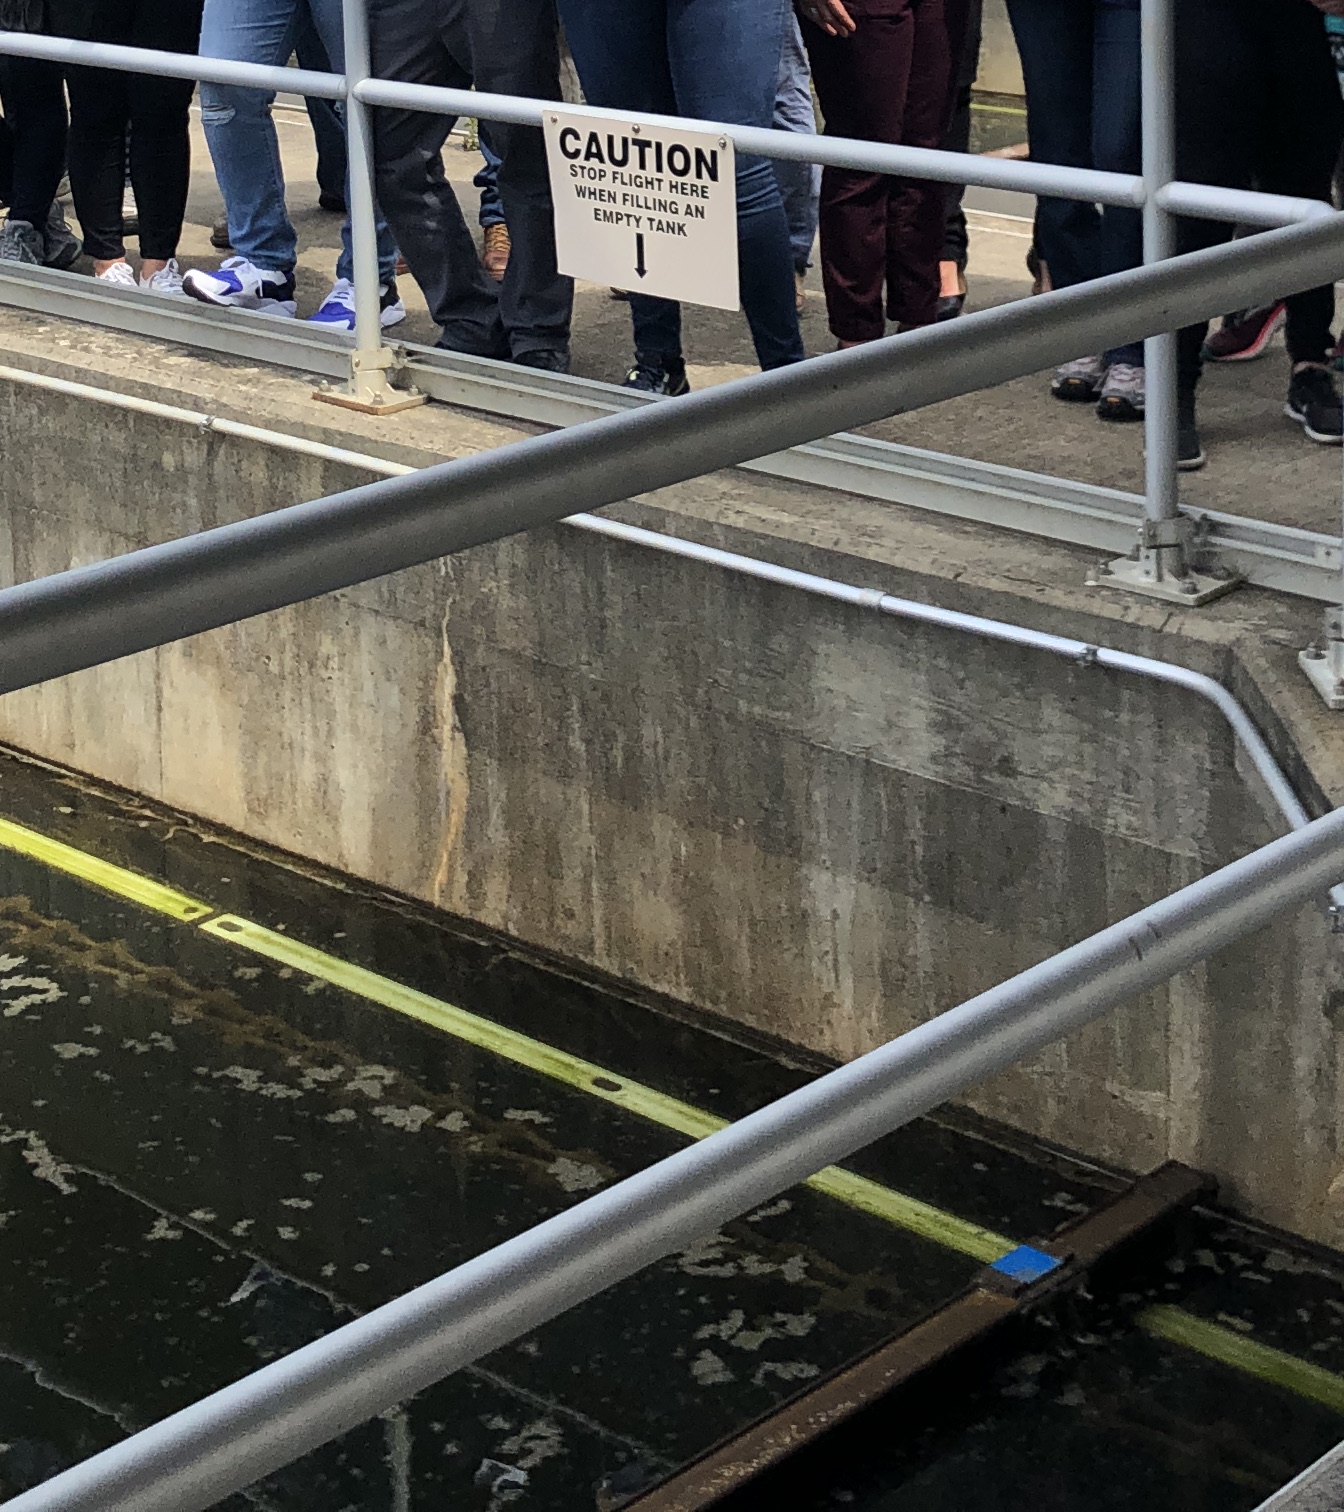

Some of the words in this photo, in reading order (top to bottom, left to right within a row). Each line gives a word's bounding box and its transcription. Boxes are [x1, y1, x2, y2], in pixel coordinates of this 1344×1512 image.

[559, 127, 719, 182] CAUTION
[569, 163, 607, 181] STOP
[612, 171, 663, 192] FLIGHT
[668, 180, 710, 200] HERE
[574, 184, 617, 204] WHEN
[622, 193, 679, 215] FILLING
[684, 203, 705, 219] AN
[593, 208, 642, 229] EMPTY
[647, 217, 688, 237] TANK
